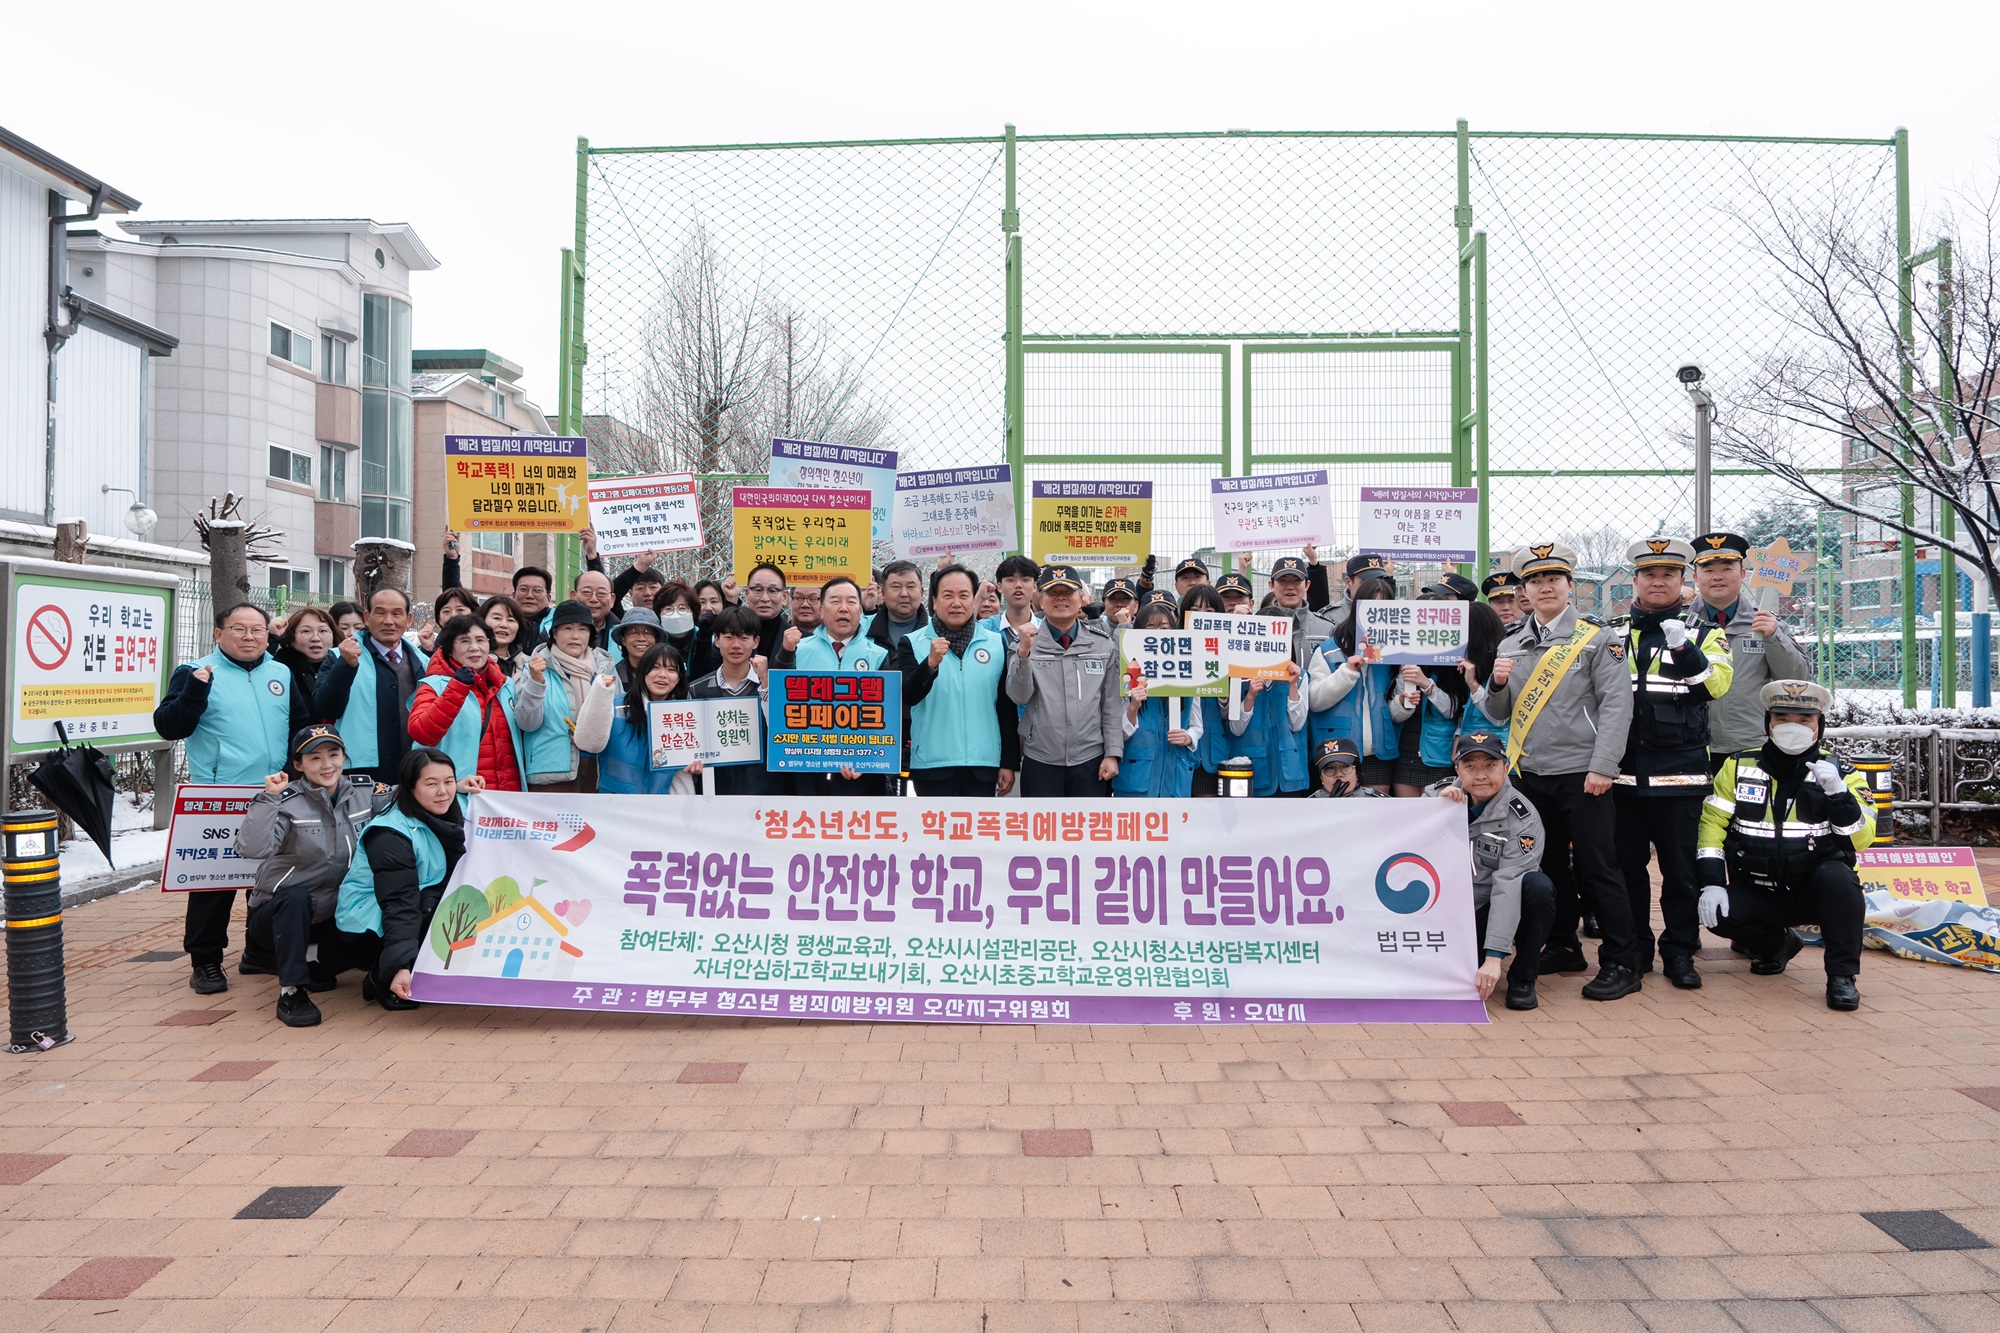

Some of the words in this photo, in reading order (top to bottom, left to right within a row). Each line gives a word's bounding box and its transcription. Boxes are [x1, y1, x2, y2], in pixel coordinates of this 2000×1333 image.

[481, 439, 520, 453] 법질서의
[803, 444, 838, 460] 법질서의
[457, 461, 515, 479] 학교폭력!
[523, 466, 543, 479] 너의
[547, 466, 577, 479] 미래와
[800, 466, 830, 482] 창의적인
[833, 470, 863, 486] 청소년이
[918, 473, 952, 486] 법질서의
[1240, 478, 1273, 490] 법질서의
[491, 482, 510, 495] 나의
[515, 483, 545, 496] 미래가
[591, 490, 620, 500] 텔레그램
[621, 486, 662, 497] 딥페이크방지
[663, 484, 690, 494] 행동요령
[1062, 483, 1095, 495] 법질서의
[1391, 490, 1421, 500] 법질서의
[472, 499, 513, 513] 달라질수
[517, 500, 561, 513] 있습니다.
[602, 502, 650, 515] 소셜미디어에
[654, 500, 685, 511] 올린사진
[812, 495, 826, 504] 다시
[828, 496, 867, 508] 청소년이다!
[904, 495, 919, 508] 조금
[921, 492, 952, 506] 부족해도
[954, 491, 969, 504] 지금
[1224, 502, 1243, 515] 친구의
[1246, 501, 1259, 514] 말에
[1261, 499, 1274, 512] 귀를
[1276, 498, 1296, 511] 기울여
[623, 516, 640, 525] 삭제
[643, 513, 667, 523] 비공개
[922, 508, 952, 522] 그대로를
[954, 506, 977, 520] 존중해
[1057, 505, 1079, 518] 주먹을
[1081, 505, 1103, 518] 이기는
[1105, 506, 1127, 519] 손가락
[1373, 508, 1400, 519] 친구의
[1404, 509, 1431, 520] 아픔을
[1435, 509, 1462, 520] 모른척
[597, 528, 628, 539] 카카오톡
[631, 525, 670, 537] 프로필사진
[673, 522, 696, 532] 지우기
[751, 516, 797, 531] 폭력없는
[802, 516, 847, 531] 우리학교
[965, 521, 1000, 537] 믿어주고!
[1039, 521, 1061, 533] 사이버
[1064, 521, 1093, 533] 폭력모든
[1095, 521, 1117, 533] 학대와
[1119, 521, 1142, 533] 폭력을
[1238, 517, 1264, 530] 무관심도
[1397, 522, 1415, 532] 하는
[1420, 522, 1437, 533] 것은
[753, 535, 799, 550] 밝아지는
[804, 536, 849, 548] 우리미래
[1393, 535, 1419, 545] 또다른
[1424, 535, 1441, 545] 폭력
[804, 555, 848, 570] 함께해요
[89, 604, 112, 628] 우리
[120, 606, 153, 630] 학교는
[1366, 607, 1411, 624] 상처받은
[1416, 608, 1461, 625] 친구마음
[1237, 621, 1267, 636] 신고는
[1271, 621, 1288, 635] 117
[1367, 628, 1410, 646] 감싸주는
[1416, 629, 1461, 647] 우리우정
[83, 634, 106, 672] 전부
[115, 635, 157, 673] 금연구역
[1143, 637, 1192, 655] 욱하면
[1204, 637, 1219, 655] 퍽
[1227, 639, 1250, 652] 생명을
[1254, 640, 1288, 653] 살립니다.
[1143, 660, 1192, 679] 참으면
[1205, 660, 1219, 679] 벗
[1537, 668, 1555, 688] 우리
[785, 675, 884, 702] 텔레그램
[1521, 686, 1544, 712] 사회의
[662, 711, 697, 729] 폭력은
[716, 710, 750, 727] 상처는
[784, 703, 885, 730] 딥페이크
[1515, 710, 1530, 729] 약속
[661, 732, 700, 749] 한순간,
[717, 728, 750, 746] 영원히
[773, 734, 799, 744] 소지만
[801, 734, 819, 744] 해도
[821, 734, 838, 744] 처벌
[840, 734, 866, 745] 대상이
[868, 735, 896, 745] 됩니다.
[804, 748, 822, 756] 디지털
[843, 748, 855, 756] 신고
[879, 749, 885, 757] 3
[183, 800, 222, 812] 텔레그램
[478, 816, 528, 829] 함께하는
[533, 820, 559, 832] 변화
[755, 810, 909, 842] ‘청소년선도,
[202, 828, 230, 839] SNS
[475, 827, 526, 841] 미래도시
[529, 831, 557, 842] 오산
[176, 848, 218, 860] 카카오톡
[623, 850, 775, 920] 폭력없는
[787, 852, 901, 922] 안전한
[910, 852, 995, 930] 학교,
[1006, 854, 1081, 926] 우리
[1094, 854, 1169, 926] 같이
[1180, 854, 1345, 927] 만들어요.
[1893, 878, 1939, 897] 행복한
[1944, 881, 1972, 896] 학교
[619, 928, 704, 954] 참여단체:
[711, 932, 789, 957] 오산시청
[796, 934, 897, 960] 평생교육과,
[904, 936, 1084, 964] 오산시시설관리공단,
[1091, 939, 1320, 965] 오산시청소년상담복지센터
[1377, 930, 1447, 953] 법무부
[693, 957, 932, 986] 자녀안심하고학교보내기회,
[939, 962, 1230, 989] 오산시초중고학교운영위원협의회
[645, 988, 708, 1010] 법무부
[717, 991, 780, 1013] 청소년
[788, 994, 915, 1016] 범죄예방위원
[923, 998, 1071, 1019] 오산지구위원회
[1244, 1003, 1307, 1022] 오산시
